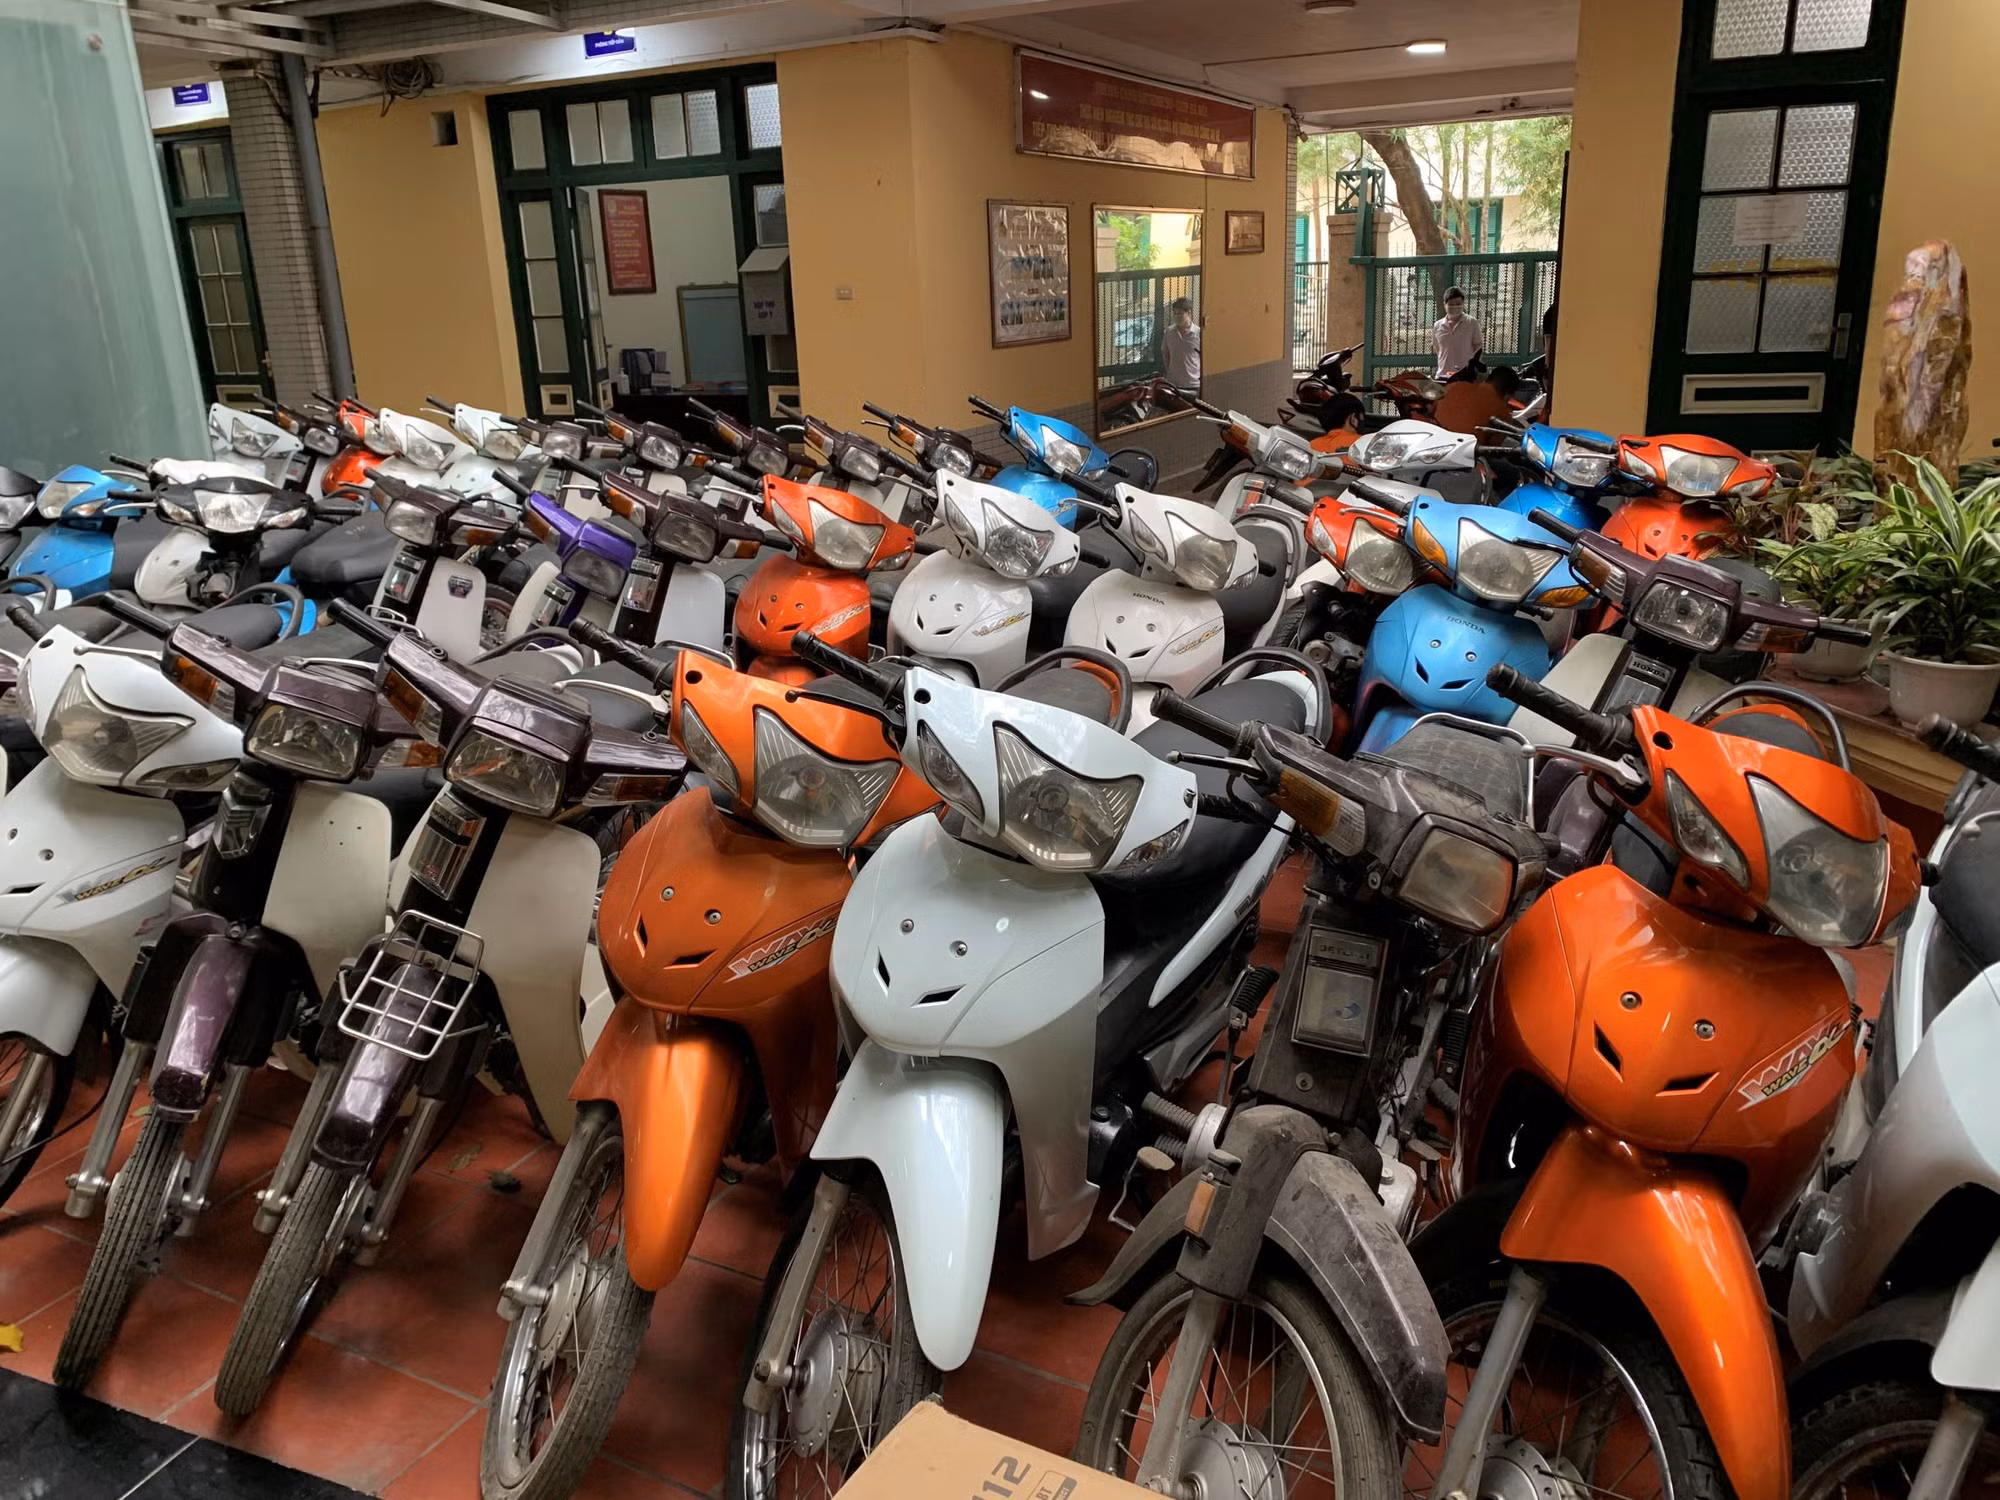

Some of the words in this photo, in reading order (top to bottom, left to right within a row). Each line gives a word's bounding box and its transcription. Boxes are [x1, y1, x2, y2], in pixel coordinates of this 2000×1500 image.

[1132, 592, 1165, 605] HONDA
[1445, 615, 1486, 635] HONDA
[1632, 660, 1666, 679] HONDA
[75, 878, 124, 901] WAVE
[747, 943, 797, 972] WAVE
[1761, 1058, 1809, 1096] WAVE
